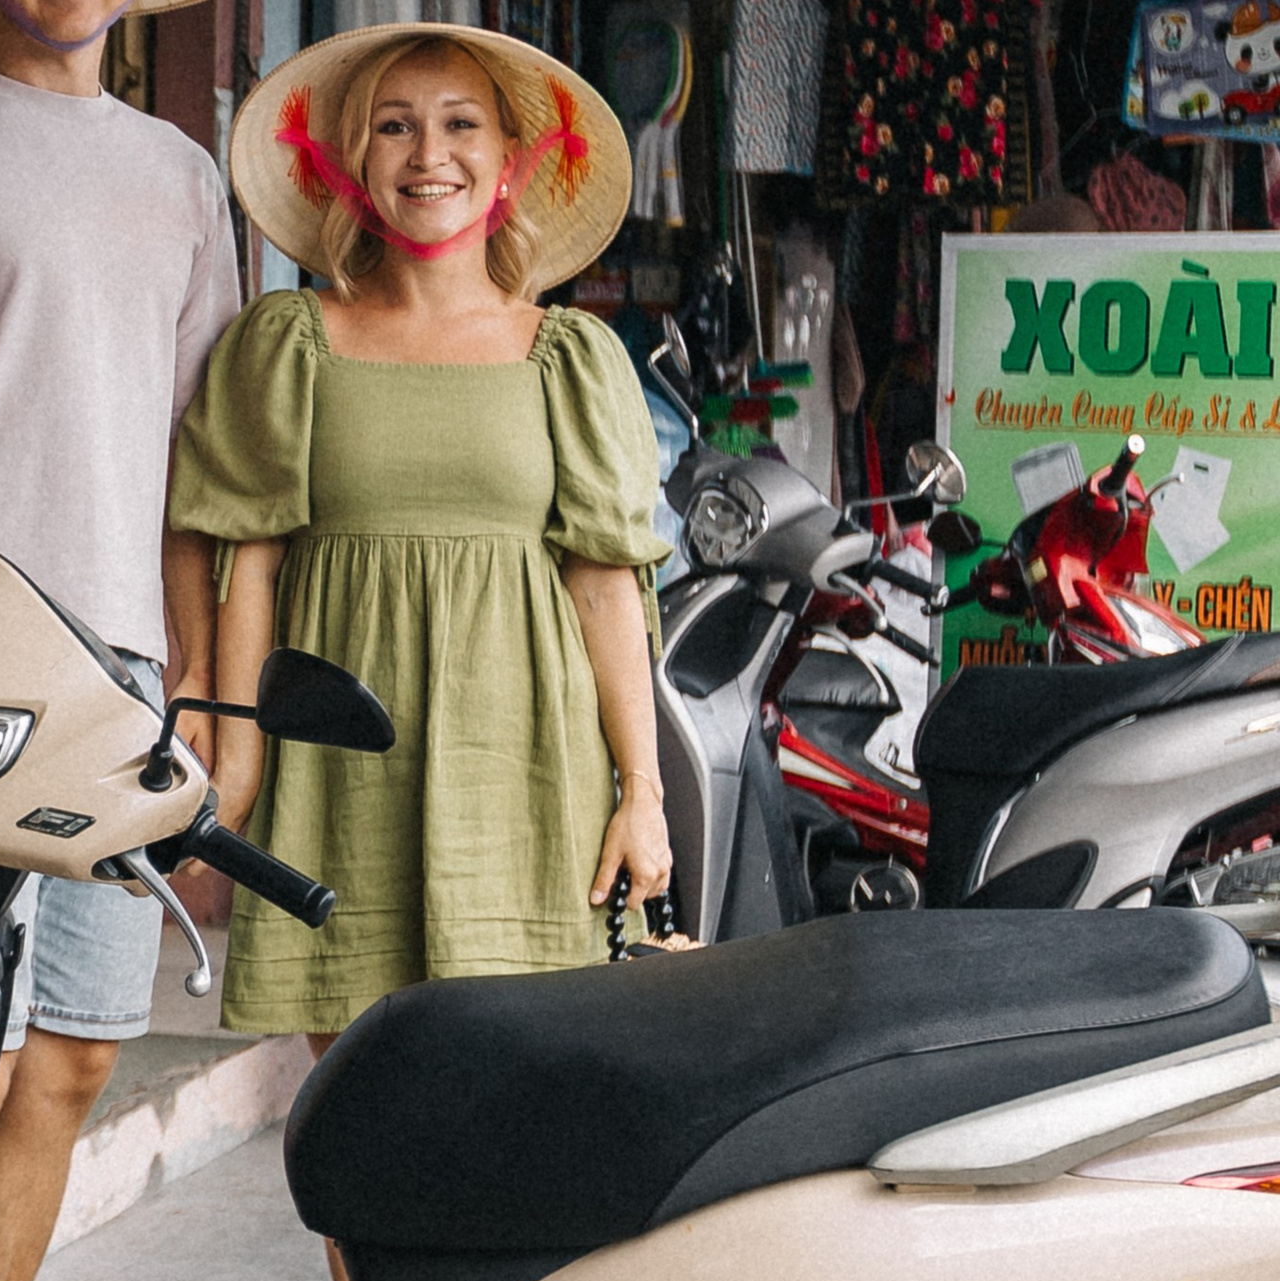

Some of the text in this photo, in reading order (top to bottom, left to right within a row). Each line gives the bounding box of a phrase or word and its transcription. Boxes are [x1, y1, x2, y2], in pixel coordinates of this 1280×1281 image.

[1001, 257, 1277, 380] XOÀI
[1072, 388, 1135, 434] Cung
[1195, 575, 1273, 633] CHÉN
